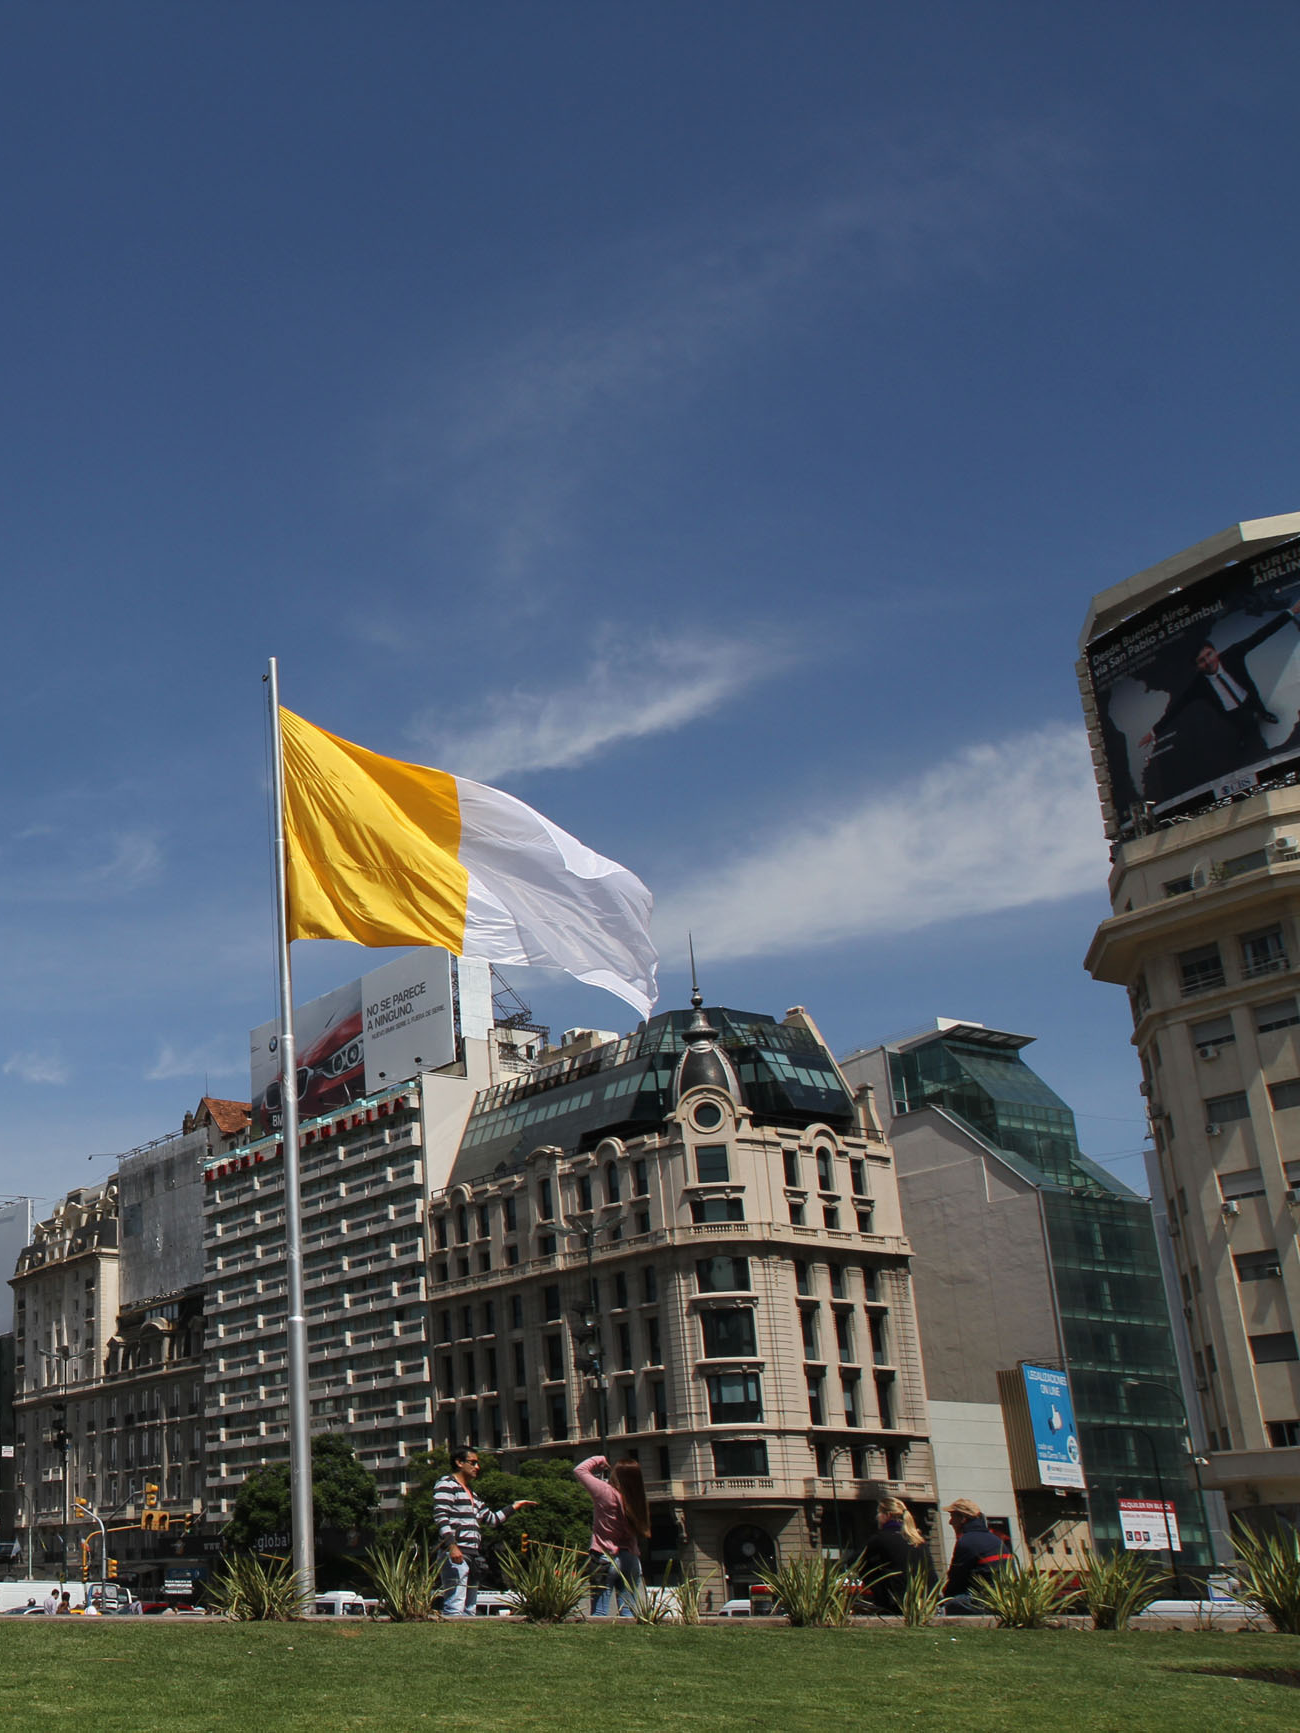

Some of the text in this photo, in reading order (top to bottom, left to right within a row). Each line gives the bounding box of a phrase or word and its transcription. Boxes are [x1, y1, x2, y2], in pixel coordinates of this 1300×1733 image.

[1092, 643, 1121, 667] Desde
[1122, 620, 1160, 647] Buenos
[1161, 604, 1190, 625] Aires
[1109, 652, 1126, 669] San
[1128, 634, 1157, 657] Pablo
[1158, 630, 1165, 640] a
[1167, 599, 1224, 635] Estambul
[366, 981, 426, 1018] NO SE PARECE
[367, 1002, 414, 1032] A NINGUNO.
